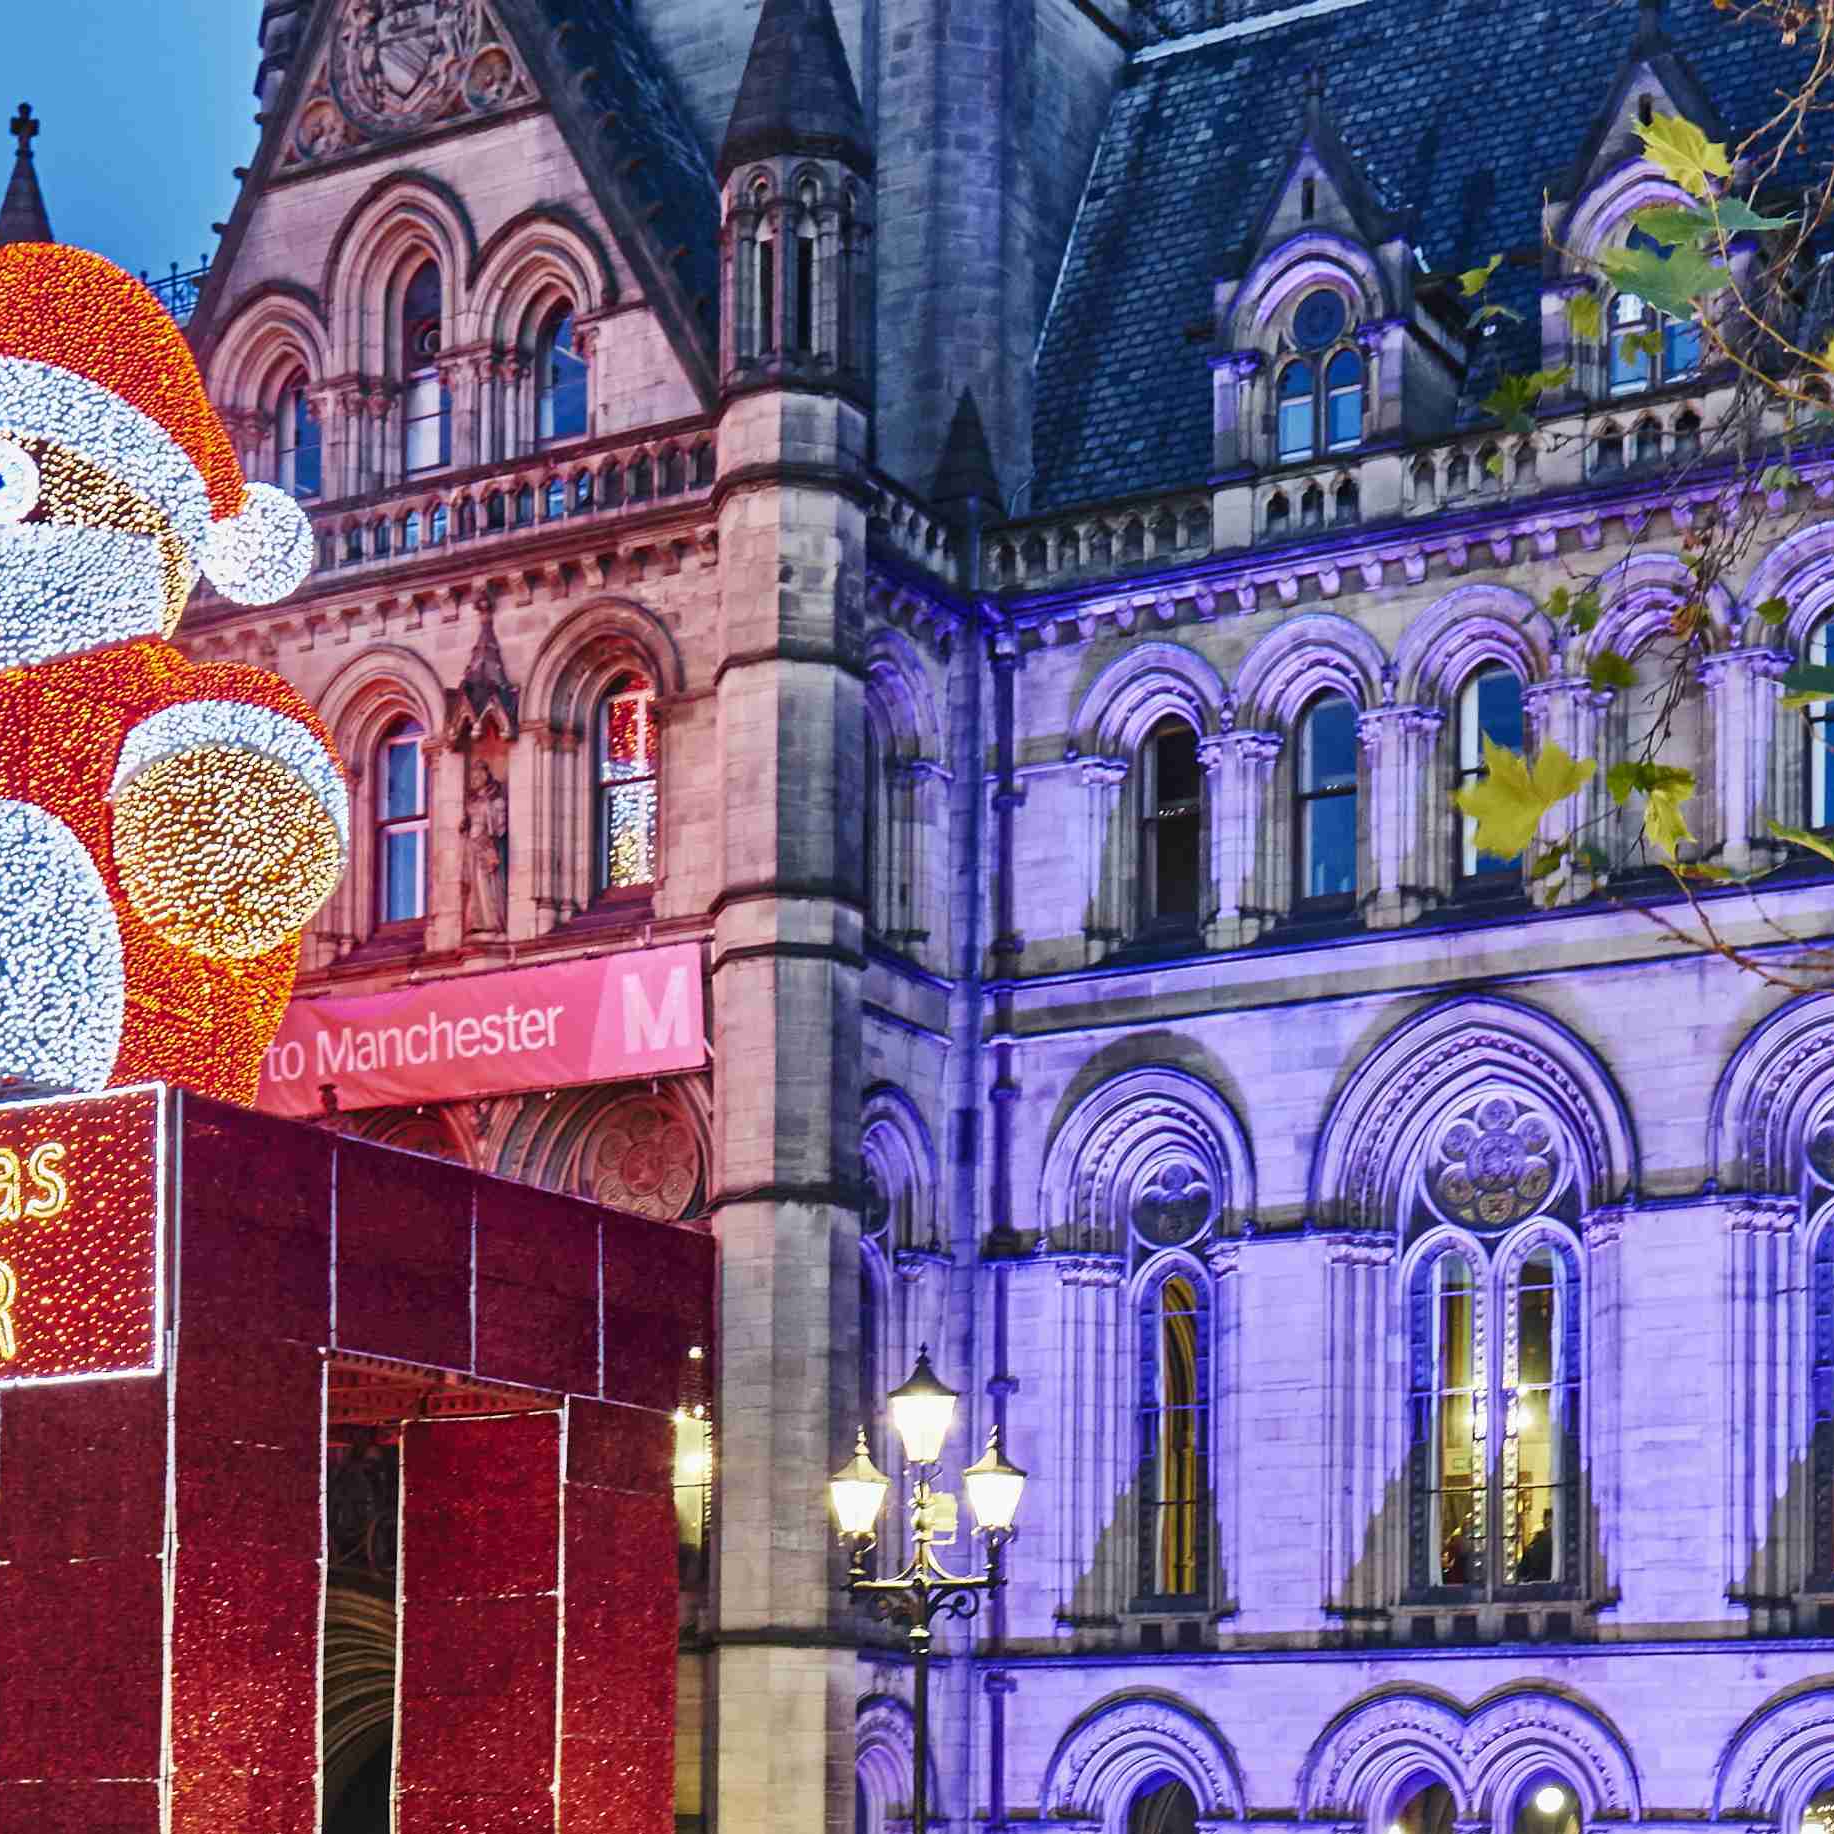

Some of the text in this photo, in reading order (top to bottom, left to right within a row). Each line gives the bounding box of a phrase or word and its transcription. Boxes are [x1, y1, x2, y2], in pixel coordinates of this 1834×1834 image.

[269, 1001, 564, 1082] to Manchester
[622, 964, 693, 1054] M
